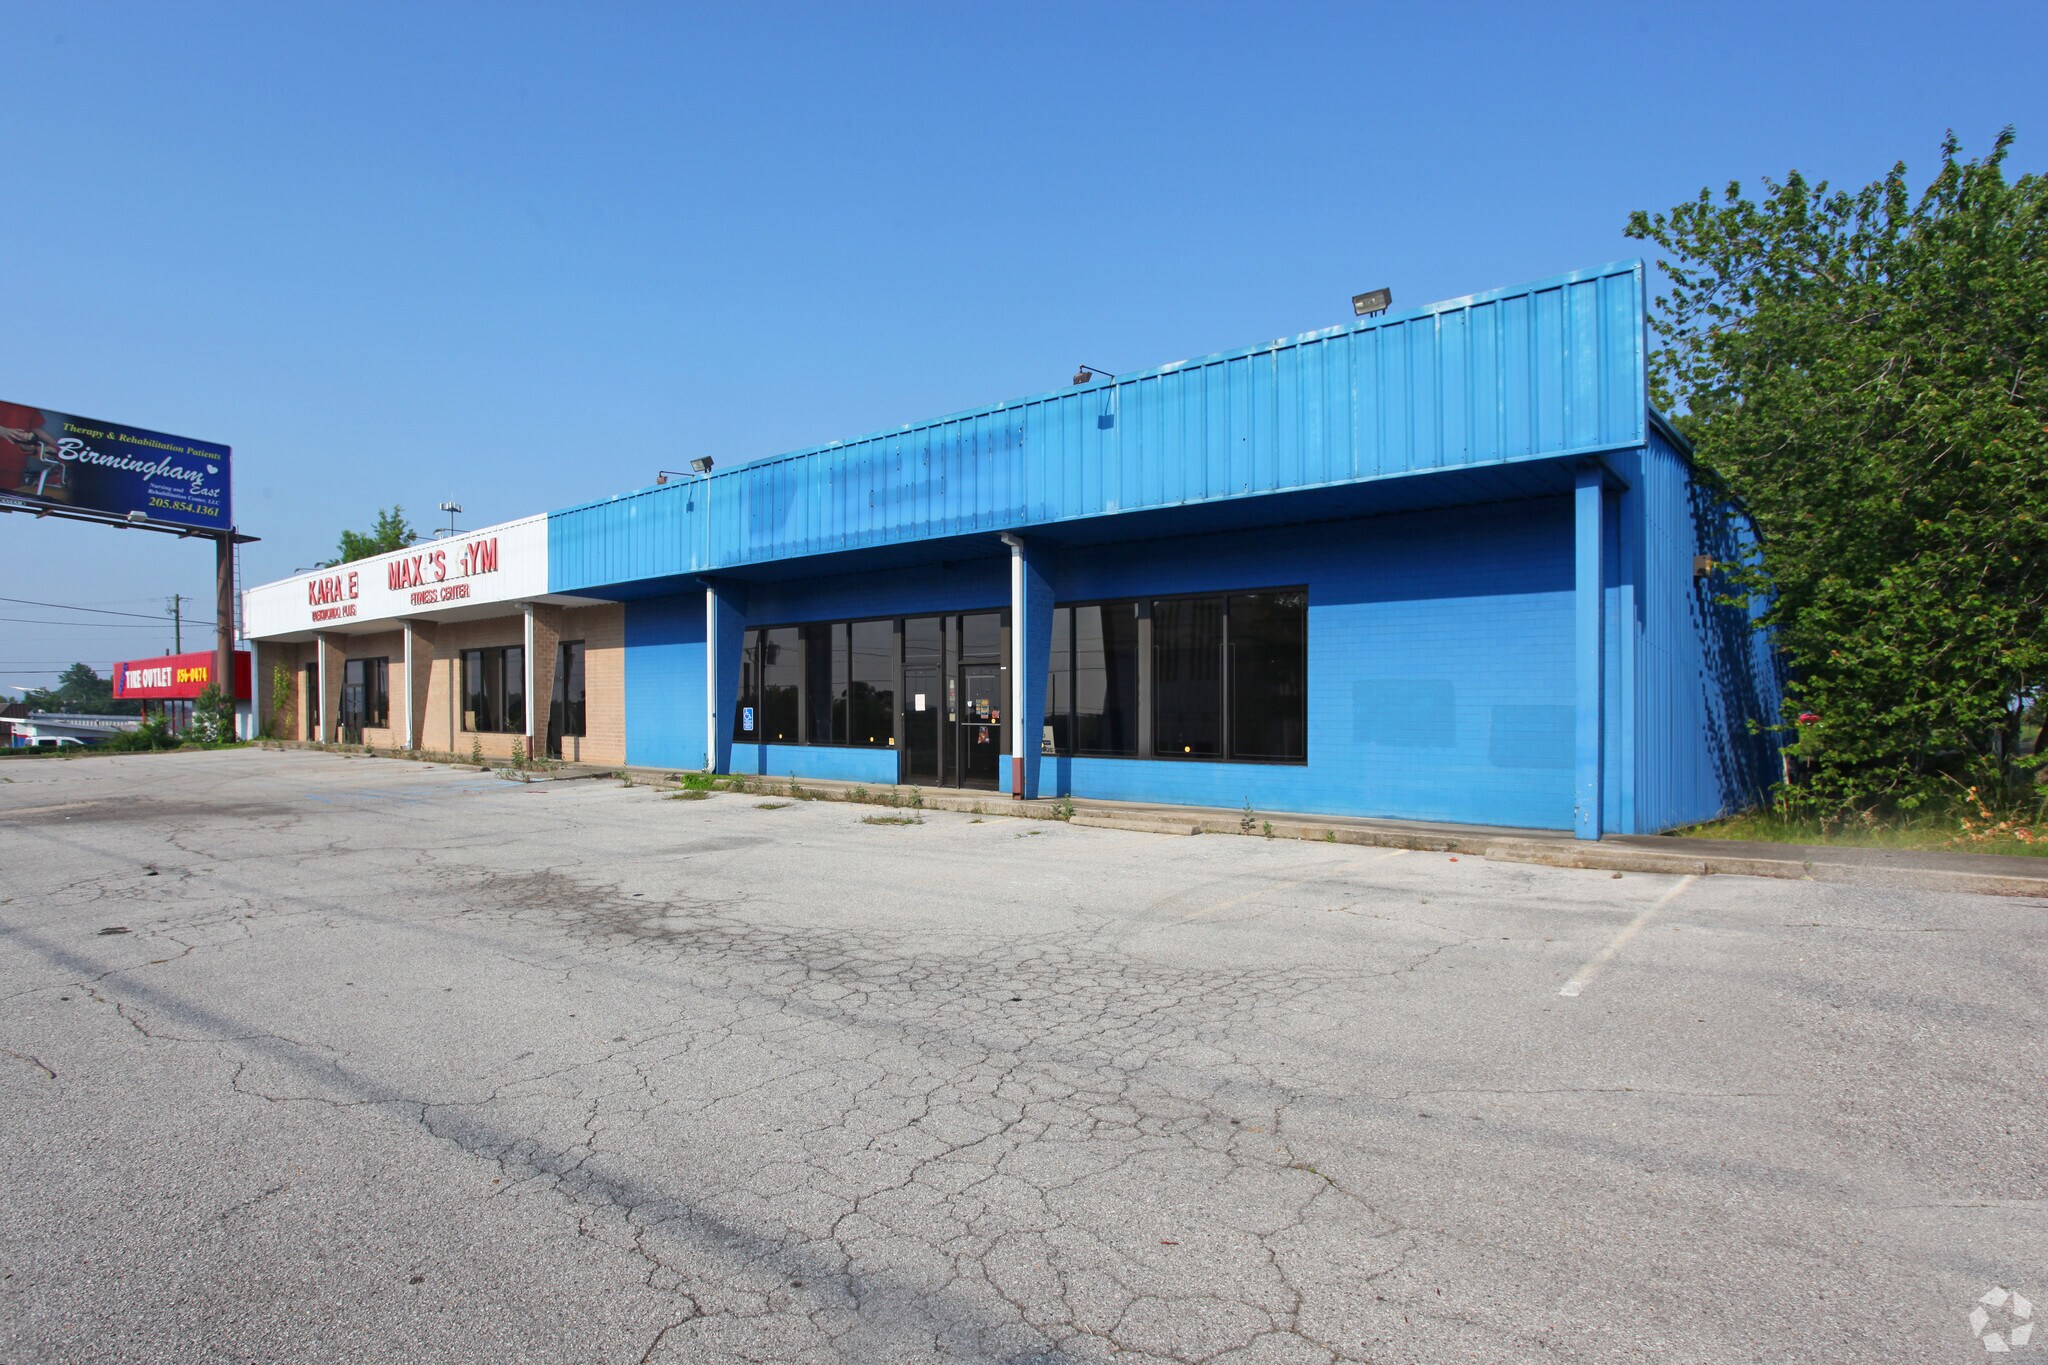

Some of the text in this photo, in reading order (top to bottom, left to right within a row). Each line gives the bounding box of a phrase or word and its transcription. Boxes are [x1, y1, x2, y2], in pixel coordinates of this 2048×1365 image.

[63, 423, 221, 460] Therapy & Rehabilitation Patients
[57, 437, 204, 482] Birmingham
[149, 482, 172, 491] Nursing
[189, 481, 220, 498] East
[148, 497, 219, 517] 205.854.1361
[387, 550, 447, 591] MAX'S
[308, 571, 359, 606] KARAE
[410, 583, 470, 606] FITNESS CENTER
[126, 670, 141, 688] TIRE
[143, 667, 172, 688] OUTLET
